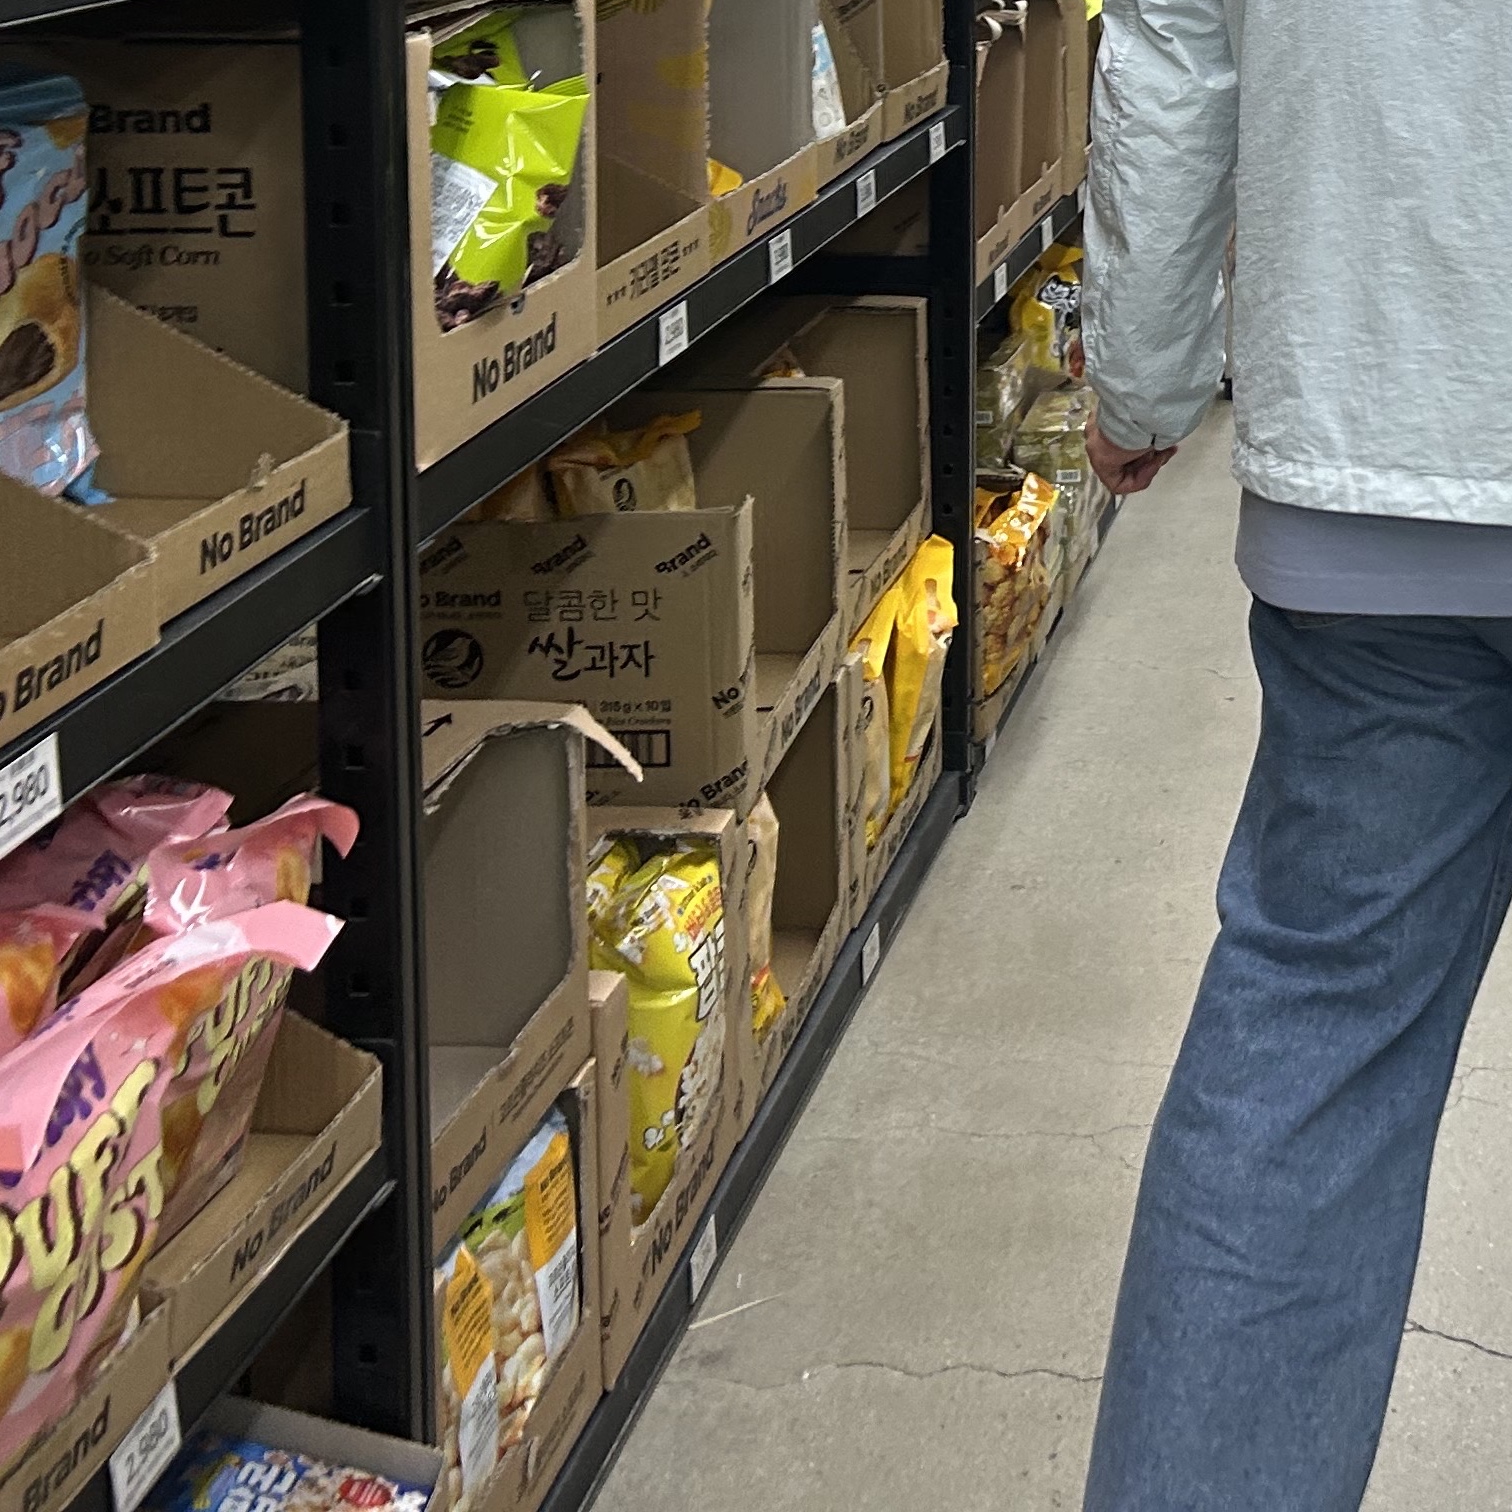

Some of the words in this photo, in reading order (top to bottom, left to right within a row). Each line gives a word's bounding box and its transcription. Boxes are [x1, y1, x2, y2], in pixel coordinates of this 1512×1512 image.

[89, 101, 212, 134] Brand
[108, 244, 154, 271] Soft
[158, 244, 221, 267] Corn
[472, 355, 499, 405] No
[502, 311, 558, 385] Brand
[200, 531, 235, 576] No
[238, 477, 308, 553] Brand
[419, 536, 464, 574] rand
[530, 533, 588, 577] Brand
[655, 532, 712, 576] Brand
[434, 589, 501, 608] Brand
[522, 587, 619, 624] 달콤한
[630, 587, 663, 623] 맛
[12, 617, 106, 713] Brand
[527, 626, 656, 682] 쌀과자
[710, 686, 741, 712] No
[230, 1230, 266, 1284] No
[267, 1139, 338, 1238] Brand
[650, 1229, 673, 1278] No
[675, 1144, 716, 1226] Brand
[22, 1393, 111, 1511] Brand
[124, 1408, 170, 1487] 2,980
